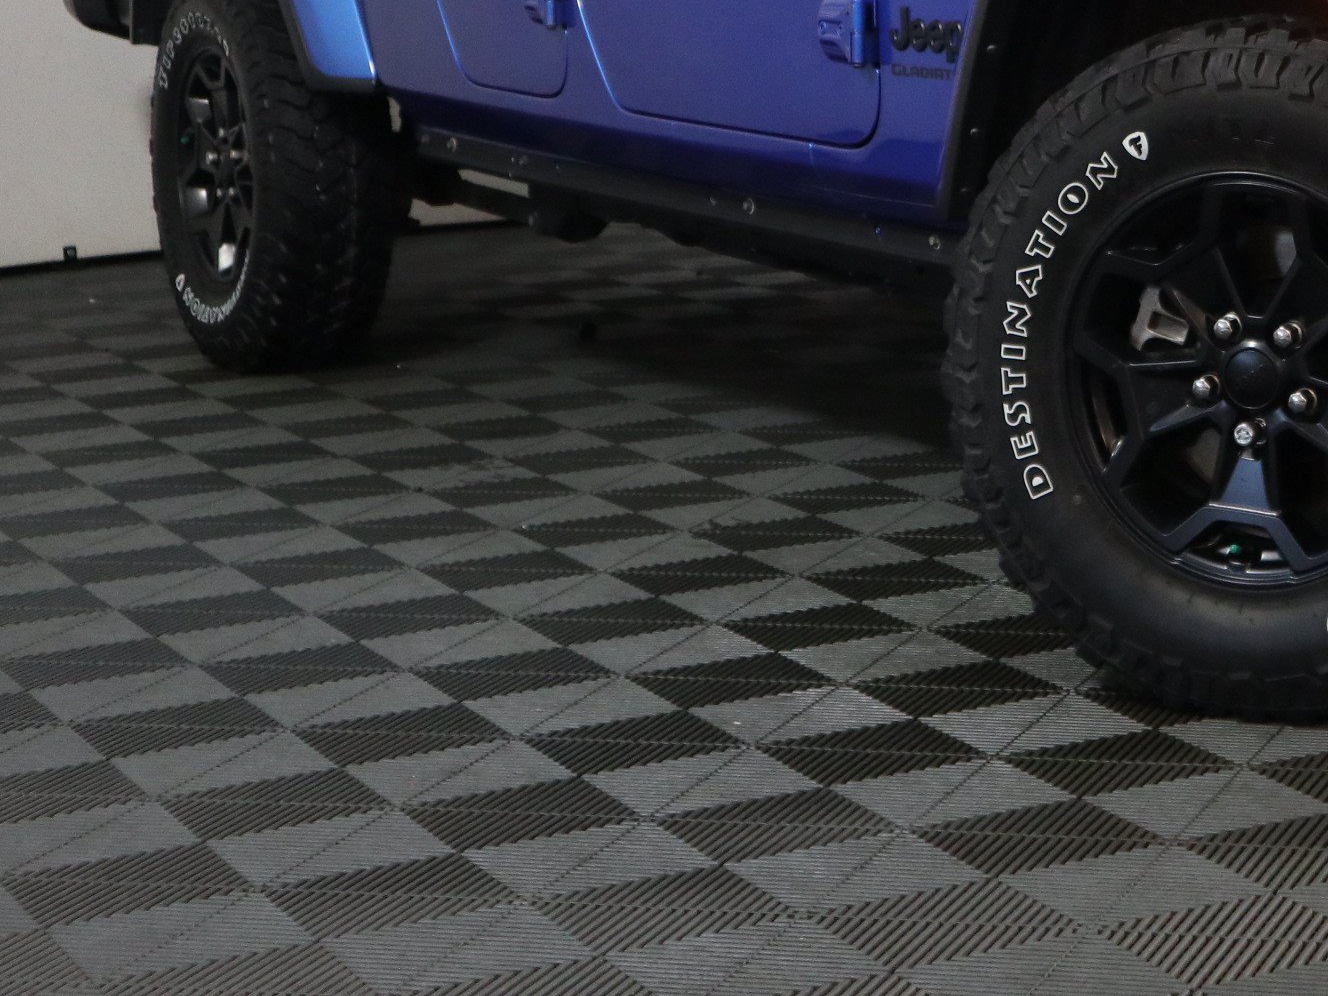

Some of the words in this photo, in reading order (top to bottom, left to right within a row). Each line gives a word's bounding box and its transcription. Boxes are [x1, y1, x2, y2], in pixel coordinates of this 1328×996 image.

[889, 6, 963, 64] Jeep
[890, 64, 953, 82] GLADIAT
[1000, 151, 1119, 500] DESTINATION
